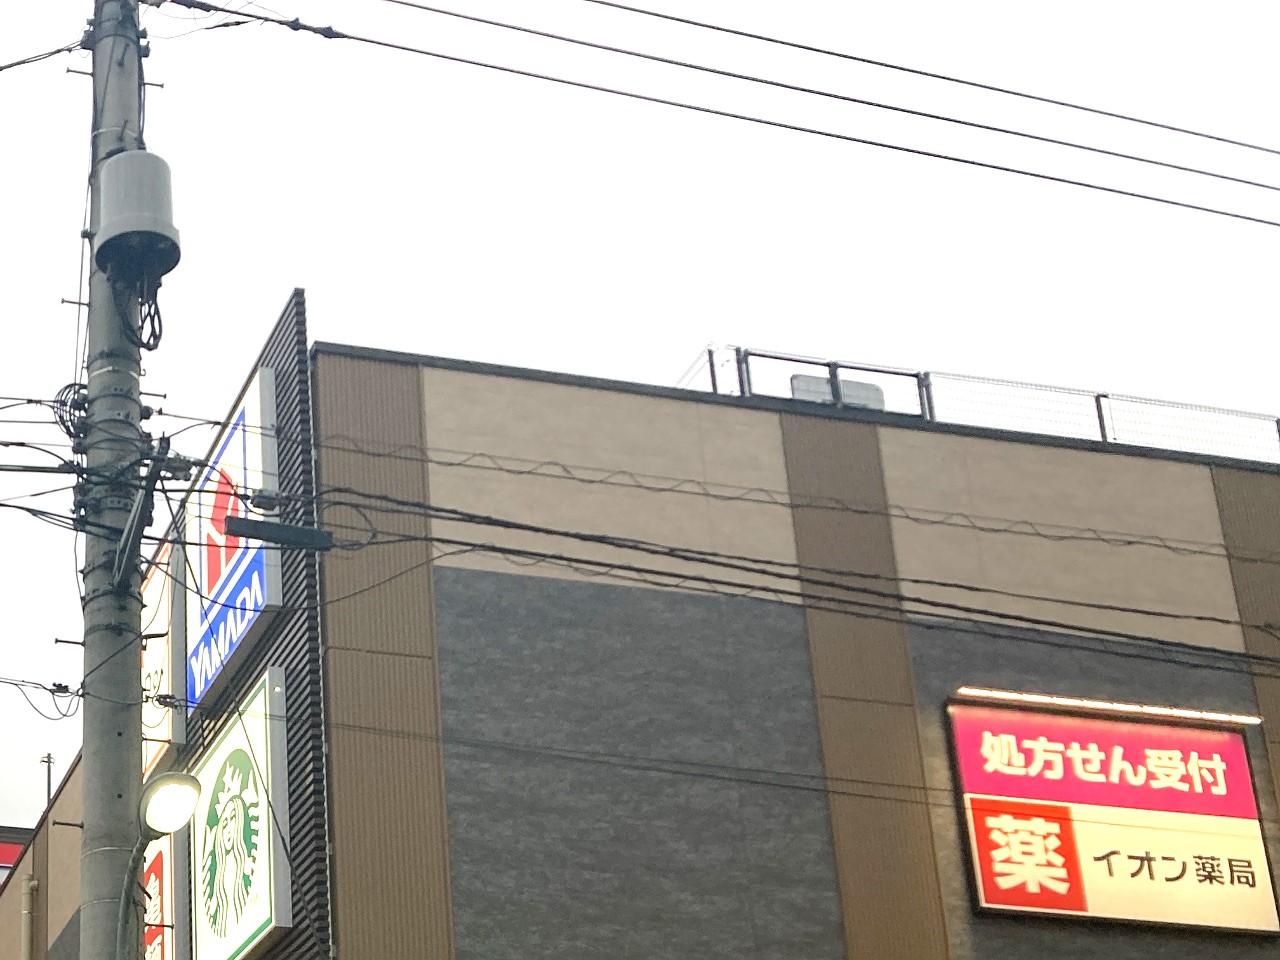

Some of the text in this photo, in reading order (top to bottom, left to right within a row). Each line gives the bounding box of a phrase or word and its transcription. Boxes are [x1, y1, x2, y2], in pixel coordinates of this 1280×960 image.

[190, 570, 263, 699] YAMADA
[980, 731, 1227, 795] 処方せん受付
[985, 814, 1070, 895] 薬
[1093, 850, 1257, 888] イオン薬局
